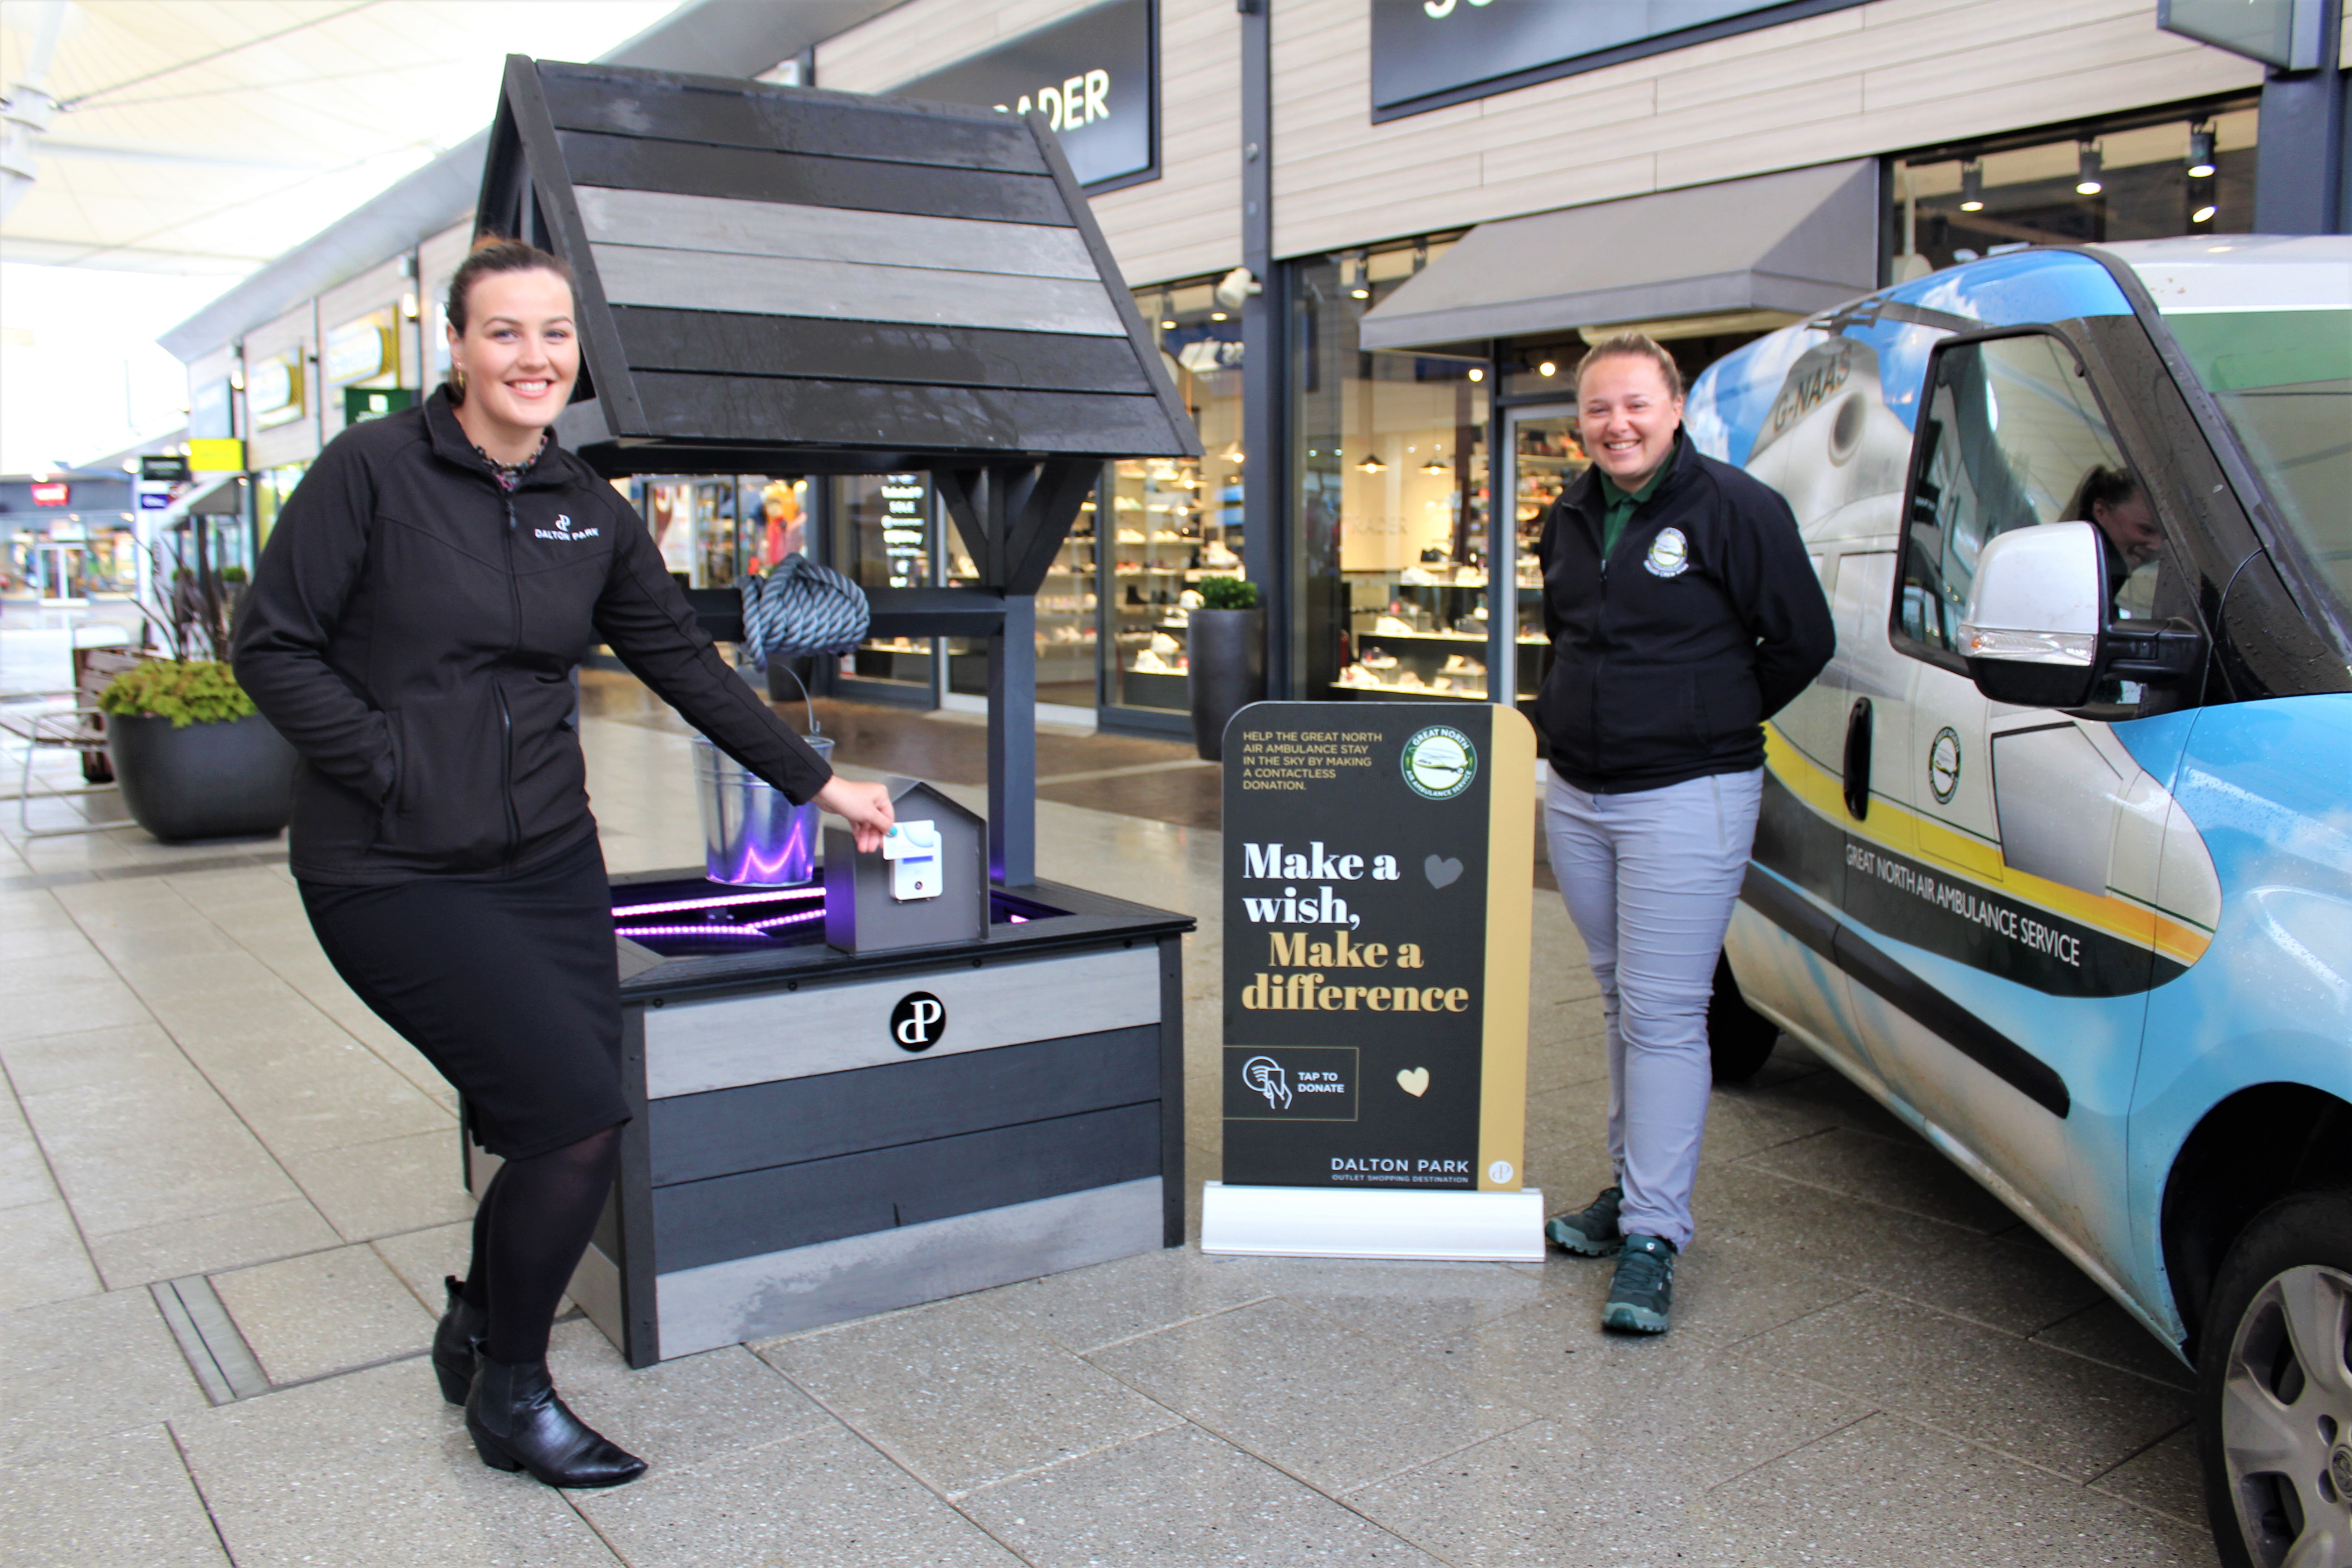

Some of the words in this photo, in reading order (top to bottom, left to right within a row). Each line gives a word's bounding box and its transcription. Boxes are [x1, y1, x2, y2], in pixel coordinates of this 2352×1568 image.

[993, 69, 1110, 132] DER
[1774, 343, 1852, 435] G-NAAS
[534, 528, 571, 541] DALTON
[571, 527, 599, 541] PARK
[1243, 731, 1273, 741] HELP
[1276, 731, 1298, 742] THE
[1300, 731, 1339, 742] GREAT
[1341, 732, 1382, 742] NORTH
[1411, 728, 1440, 746] GREAT
[1440, 728, 1470, 750] NORTH
[1243, 744, 1263, 754] AIR
[1265, 744, 1338, 755] AMBULANCE
[1341, 745, 1369, 755] STAY
[1243, 756, 1255, 765] IN
[1258, 756, 1280, 766] THE
[1283, 756, 1305, 766] SKY
[1308, 756, 1324, 766] BY
[1326, 757, 1372, 767] MAKING
[1243, 768, 1252, 778] A
[1254, 768, 1336, 779] CONTACTLESS
[1243, 780, 1307, 790] DONATION.
[1406, 769, 1416, 781] AIR
[1412, 778, 1452, 797] AMBULANCE
[1452, 769, 1473, 794] SERVICE
[1243, 841, 1364, 881] Make
[1372, 854, 1401, 881] a
[1242, 885, 1361, 930] wish,
[1846, 843, 1876, 874] GREAT
[1877, 856, 1915, 893] NORTH
[1916, 874, 1936, 903] AIR
[1936, 883, 2018, 939] AMBULANCE
[2020, 917, 2080, 967] SERVICE
[1268, 930, 1388, 968] Make
[1396, 942, 1425, 969] a
[1241, 972, 1469, 1013] difference
[1298, 1071, 1320, 1081] TAP
[1321, 1071, 1338, 1082] TO
[1298, 1083, 1345, 1093] DONATE
[1331, 1157, 1409, 1172] DALTON
[1417, 1159, 1469, 1173] PARK
[1367, 1174, 1410, 1182] SHOPPING
[1412, 1175, 1469, 1183] DESTINATION
